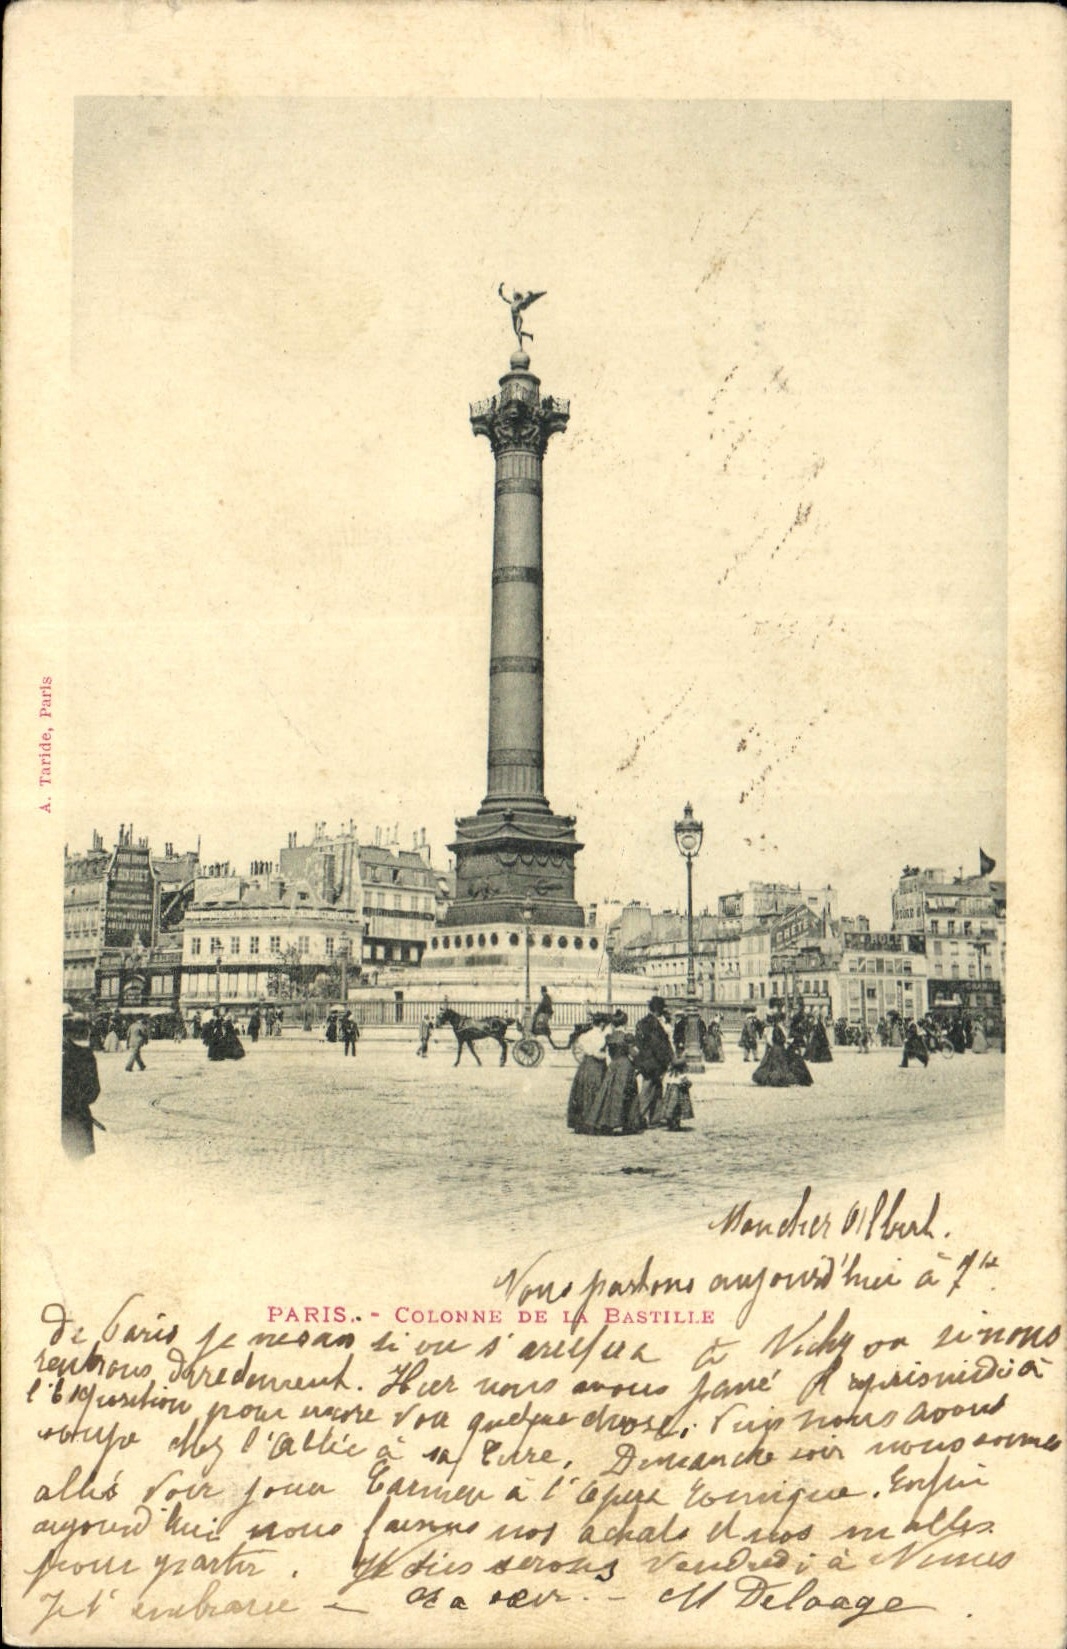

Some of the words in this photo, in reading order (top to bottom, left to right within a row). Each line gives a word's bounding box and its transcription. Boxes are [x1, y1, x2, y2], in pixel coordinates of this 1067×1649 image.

[39, 676, 52, 718] Paris
[39, 727, 54, 786] Taride,
[39, 797, 51, 814] A.
[493, 1249, 573, 1307] Nous
[395, 1306, 502, 1324] COLONNE
[517, 1310, 549, 1324] DE
[563, 1310, 590, 1324] LA
[604, 1307, 716, 1324] BASTILLE
